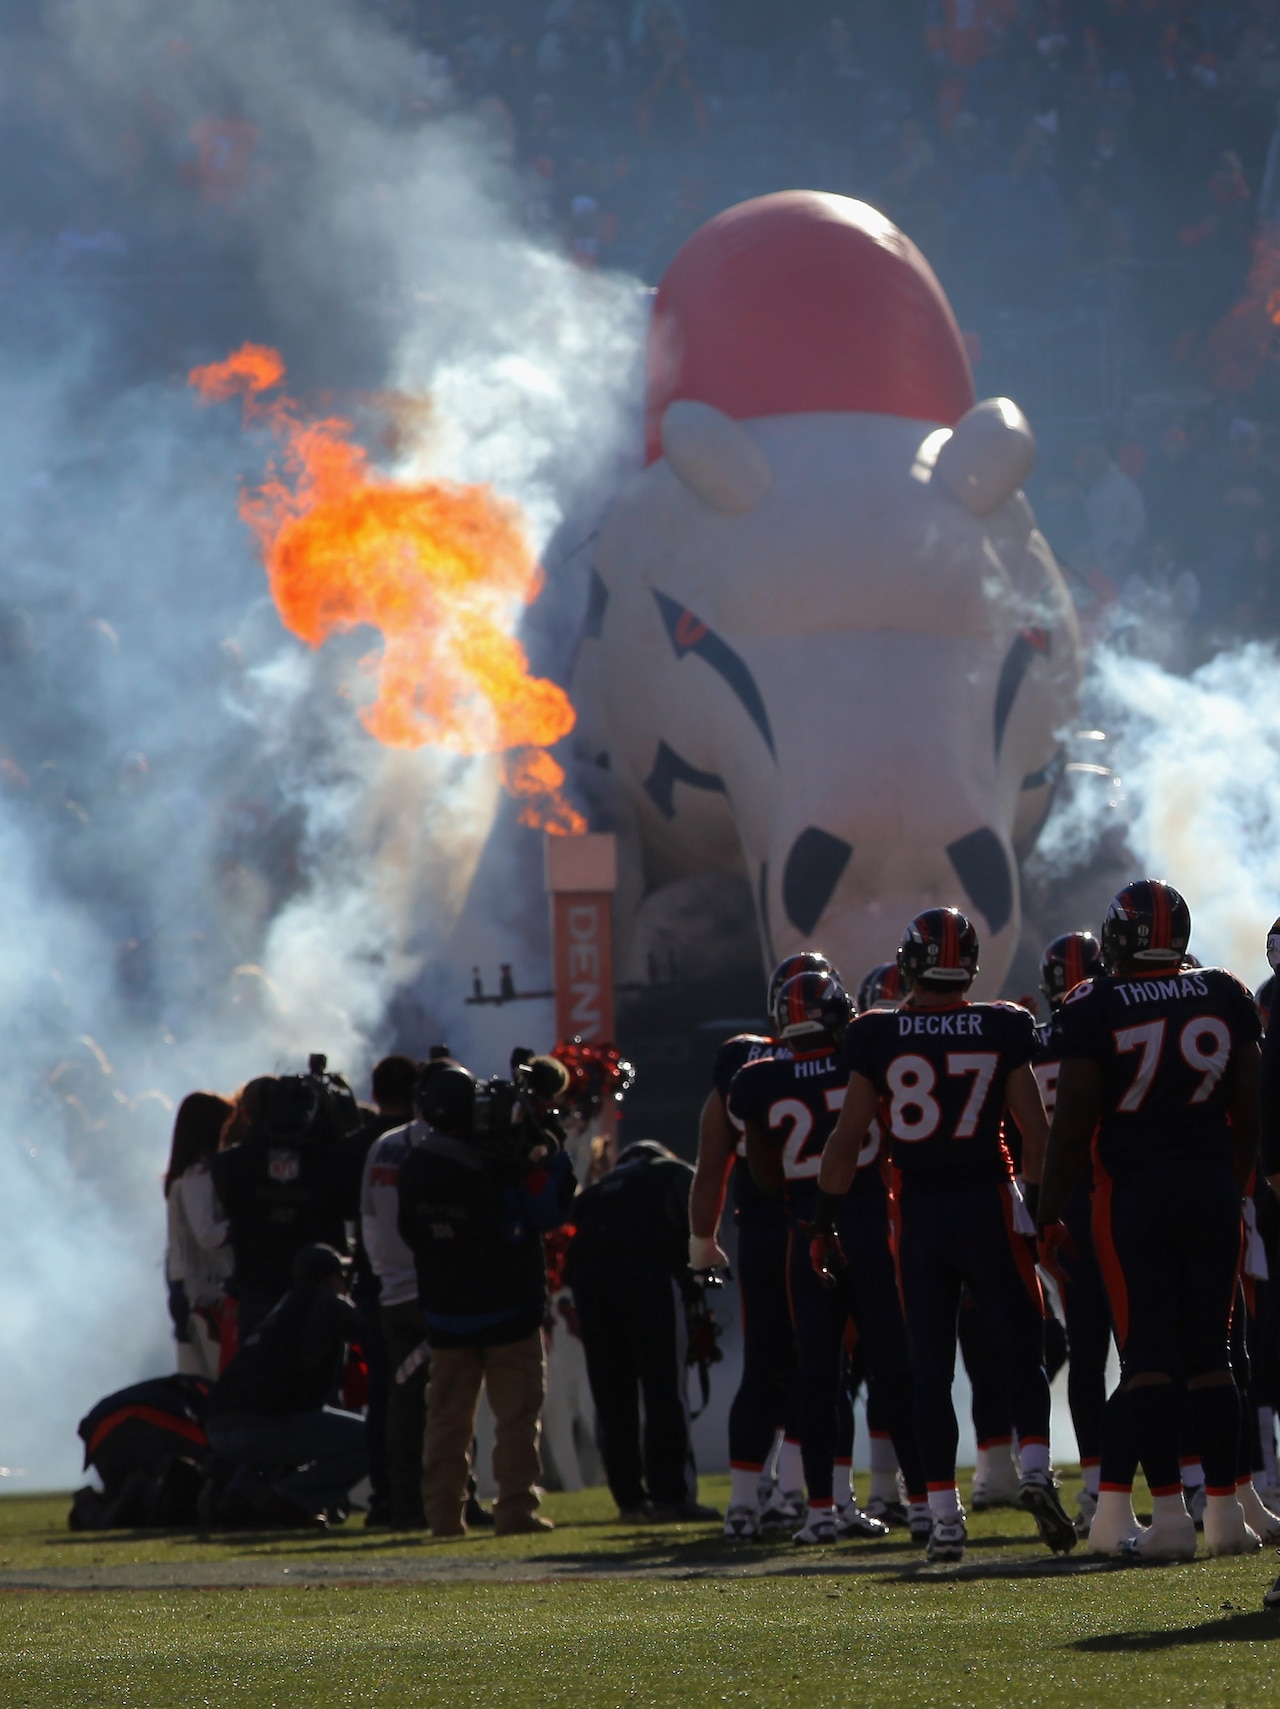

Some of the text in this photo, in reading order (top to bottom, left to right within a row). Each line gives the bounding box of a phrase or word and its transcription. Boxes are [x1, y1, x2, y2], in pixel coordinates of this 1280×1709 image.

[1137, 937, 1148, 947] 79
[1114, 975, 1209, 1006] THOMAS
[899, 1013, 983, 1036] DECKER
[794, 1056, 836, 1079] HILL
[1112, 1014, 1232, 1113] 79
[886, 1052, 1001, 1143] 87
